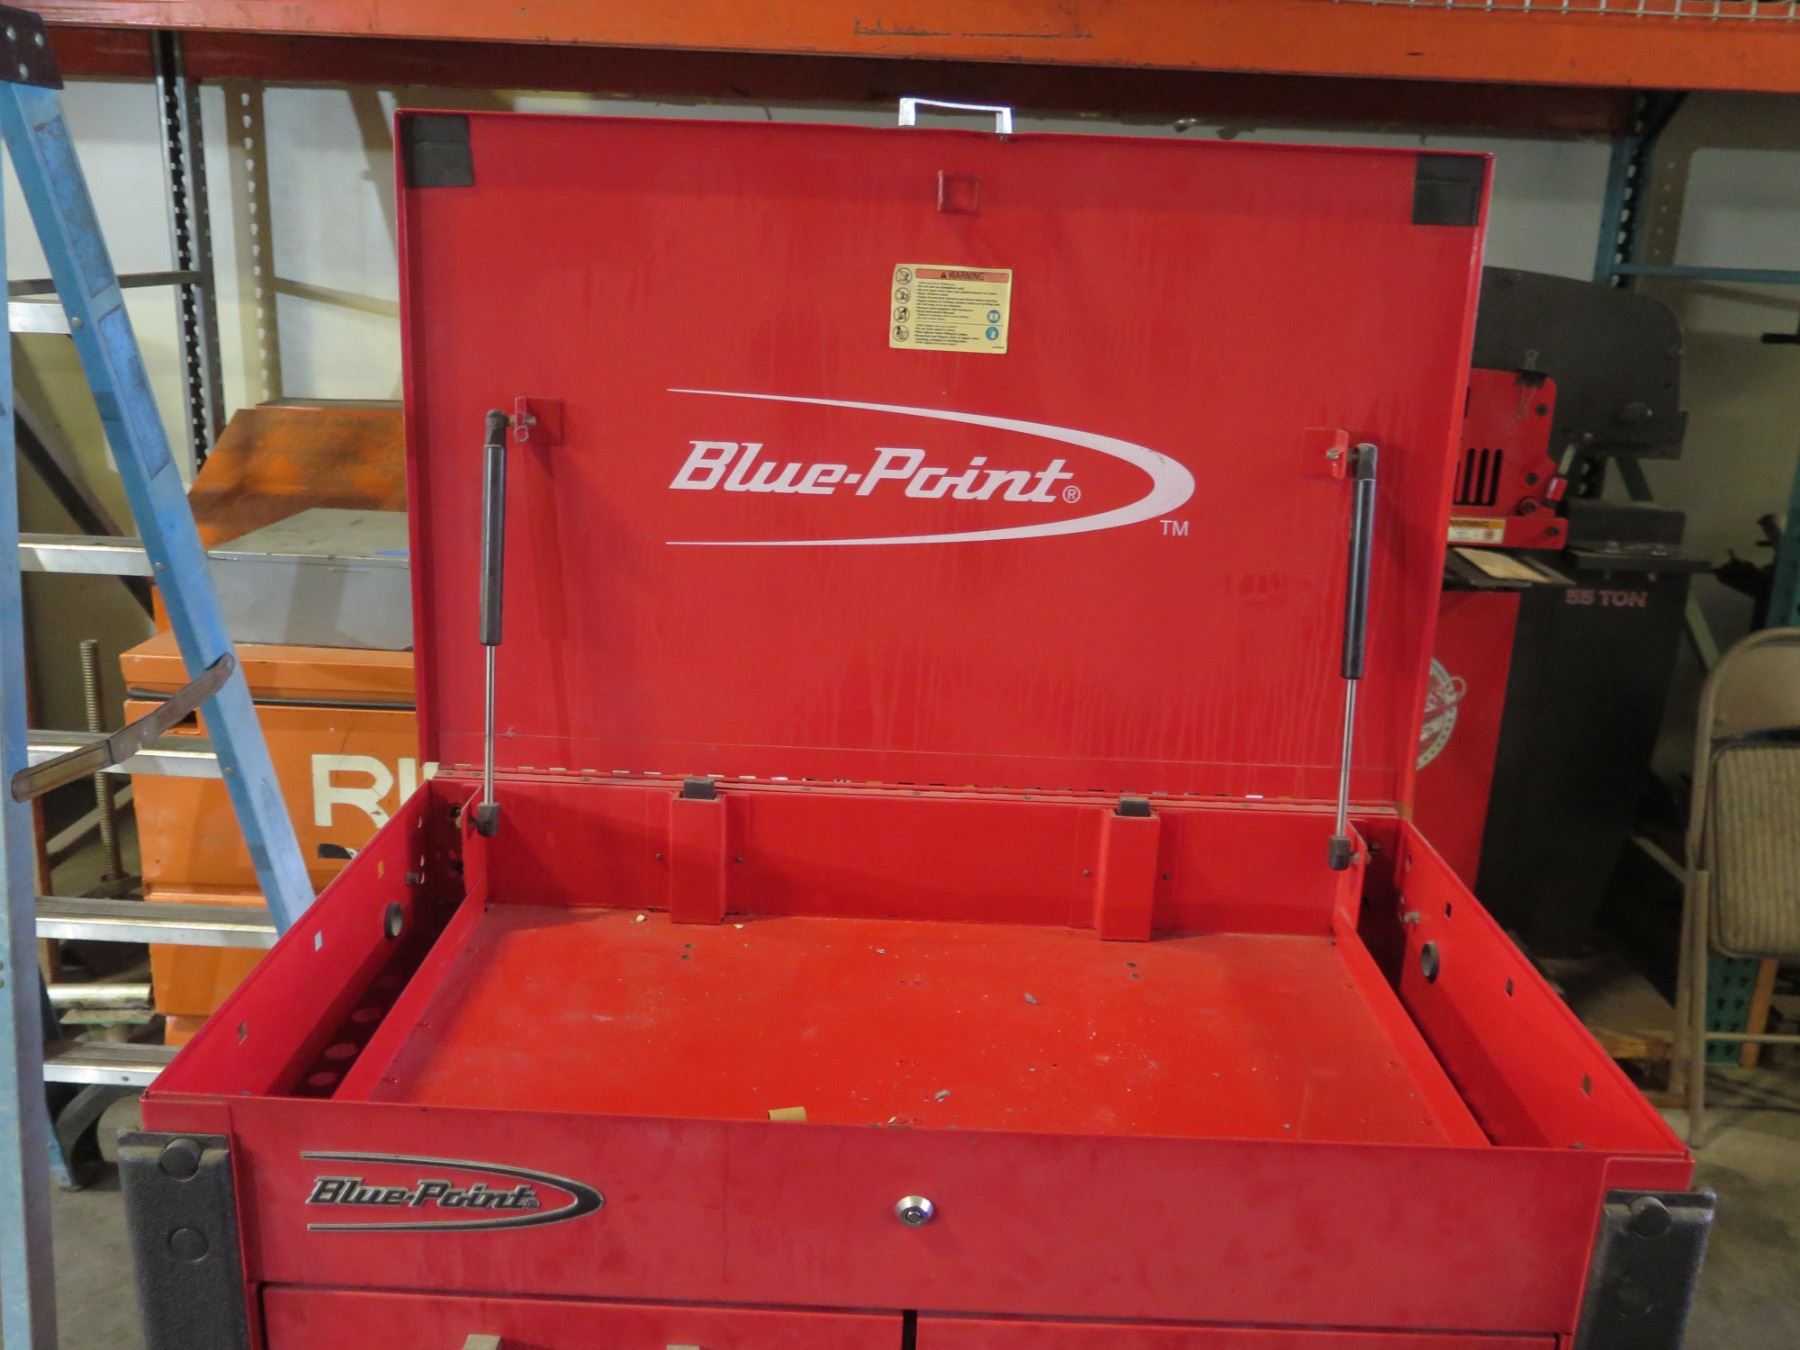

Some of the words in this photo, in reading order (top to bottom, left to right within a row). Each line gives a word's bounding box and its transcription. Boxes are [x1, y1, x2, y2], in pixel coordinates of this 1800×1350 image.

[1160, 520, 1190, 536] TM
[1565, 588, 1595, 606] 55
[1599, 589, 1649, 608] TON
[311, 754, 439, 829] RI
